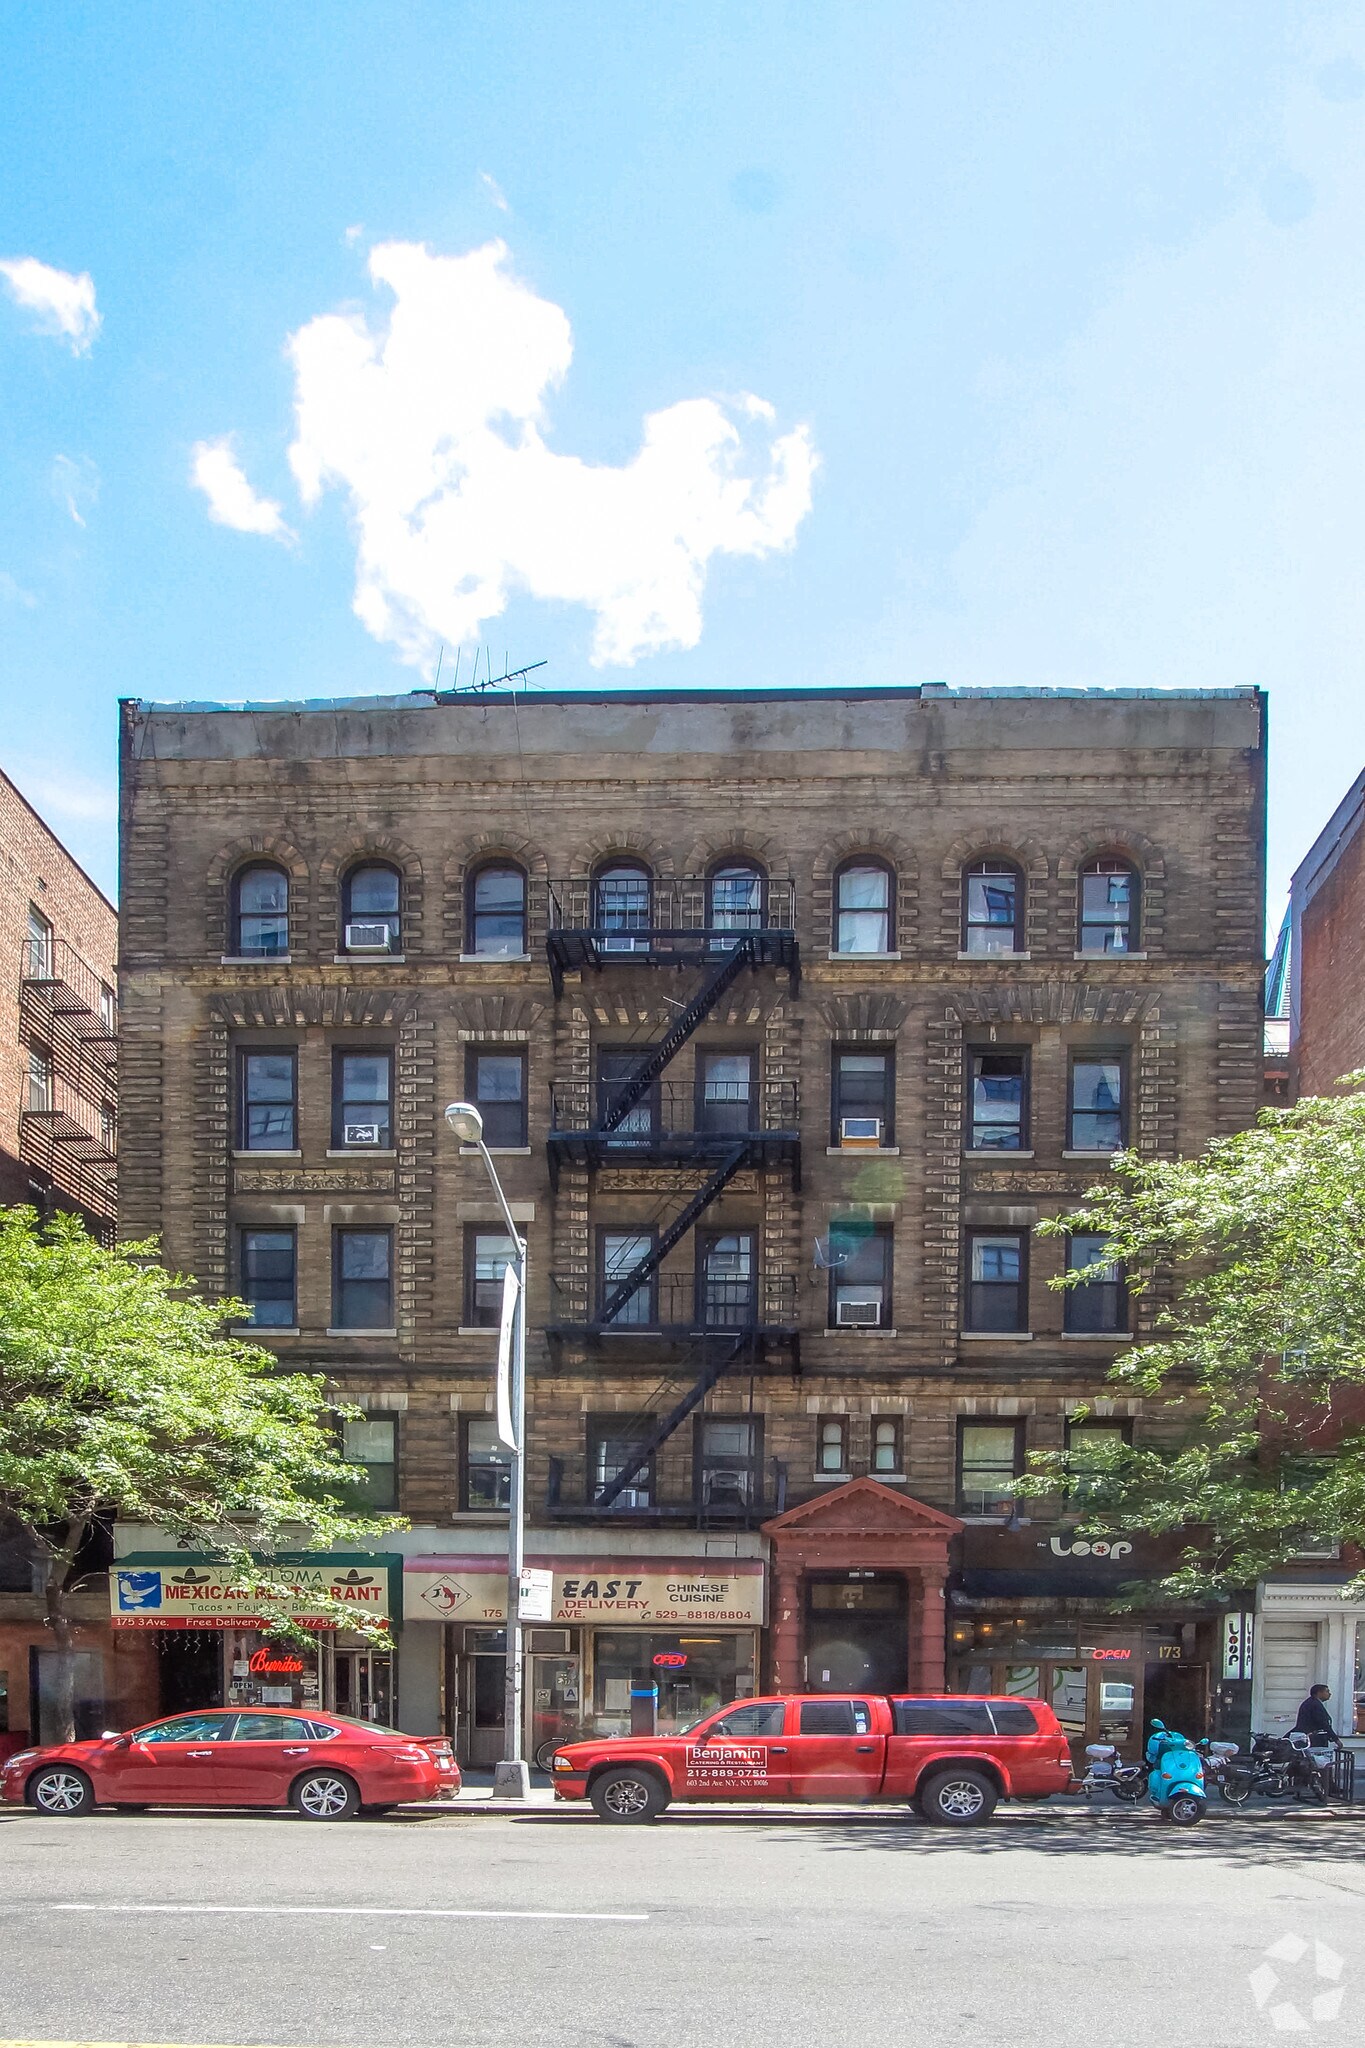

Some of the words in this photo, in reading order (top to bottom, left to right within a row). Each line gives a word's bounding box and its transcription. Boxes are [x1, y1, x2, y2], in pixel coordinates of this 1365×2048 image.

[248, 1570, 323, 1583] ALOMA
[165, 1585, 249, 1600] MEXICAN
[254, 1585, 382, 1600] RTRANT
[562, 1580, 643, 1599] EAST
[666, 1584, 729, 1593] CHINESE
[669, 1594, 725, 1603] CUISINE
[189, 1602, 223, 1612] Tacos
[237, 1602, 277, 1614] Faji
[565, 1600, 650, 1609] DELIVERY
[482, 1609, 502, 1618] 175
[556, 1610, 585, 1618] AVE.
[116, 1618, 135, 1626] 175
[186, 1618, 212, 1626] Free
[215, 1618, 261, 1628] Delivery
[1092, 1649, 1131, 1660] OPEN
[1159, 1646, 1181, 1659] 173
[249, 1647, 304, 1672] Burritos
[652, 1653, 688, 1665] OPEN
[566, 1688, 576, 1698] A
[692, 1747, 760, 1761] Benjamin
[687, 1769, 767, 1777] 212-889-0750
[686, 1779, 698, 1787] 603
[699, 1779, 710, 1787] 2nd
